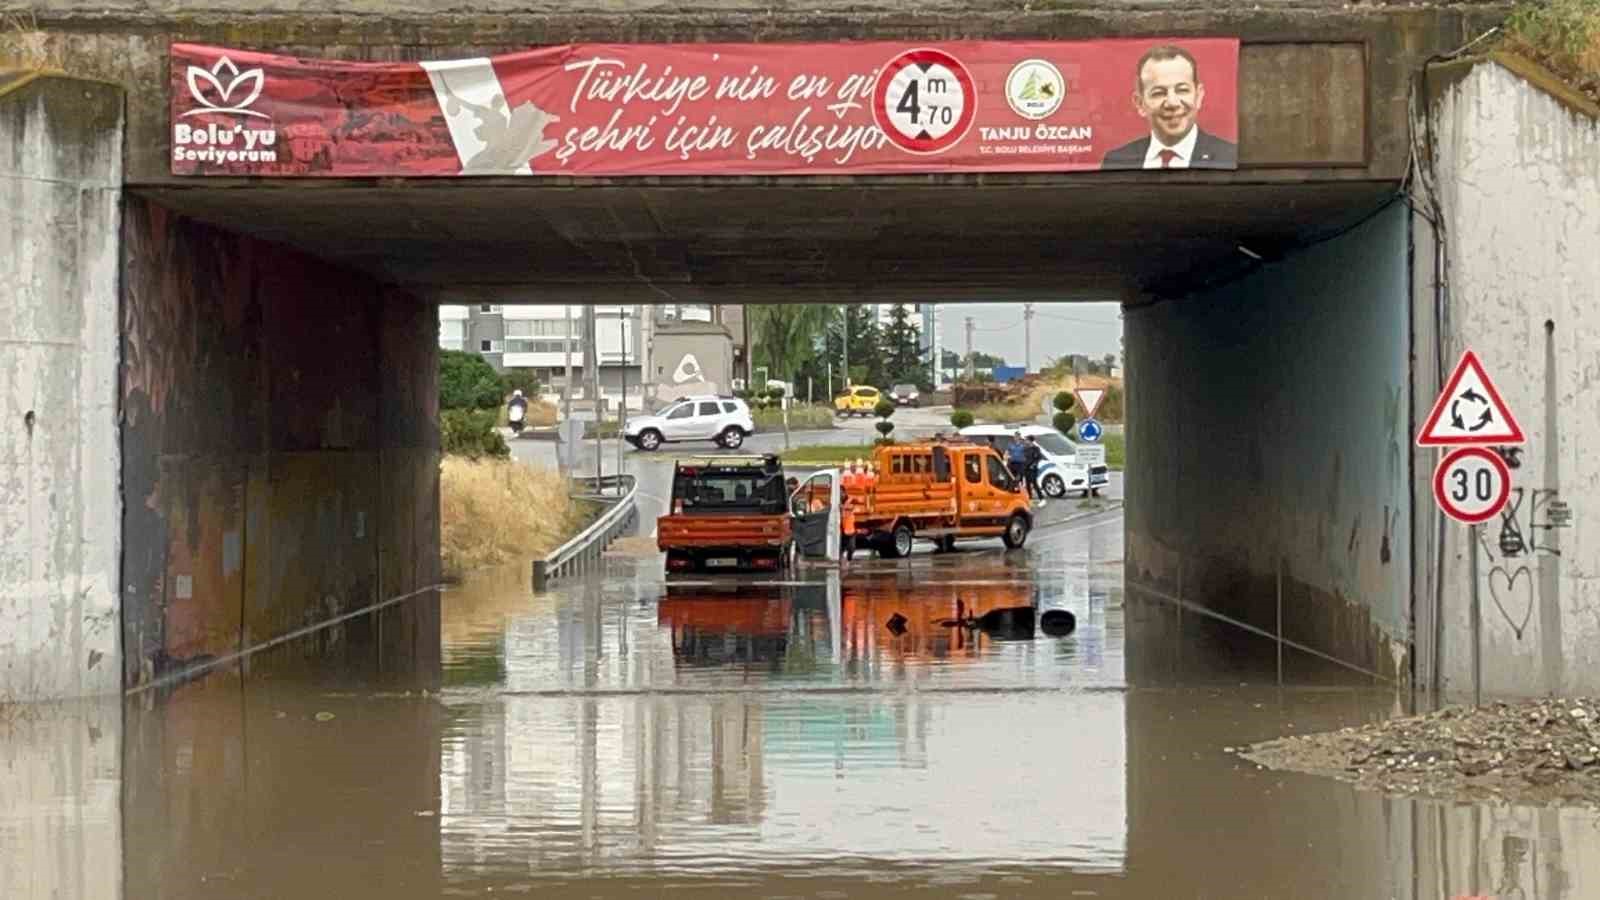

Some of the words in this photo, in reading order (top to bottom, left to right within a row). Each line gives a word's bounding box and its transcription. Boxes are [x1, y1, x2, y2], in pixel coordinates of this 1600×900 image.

[787, 73, 834, 102] en
[927, 78, 947, 94] m
[555, 108, 658, 165] şehri
[664, 115, 740, 161] için
[979, 126, 1031, 141] TANJU
[1035, 123, 1093, 141] ÖZCAN
[174, 145, 277, 165] Seviyorum
[1451, 467, 1492, 502] 30
